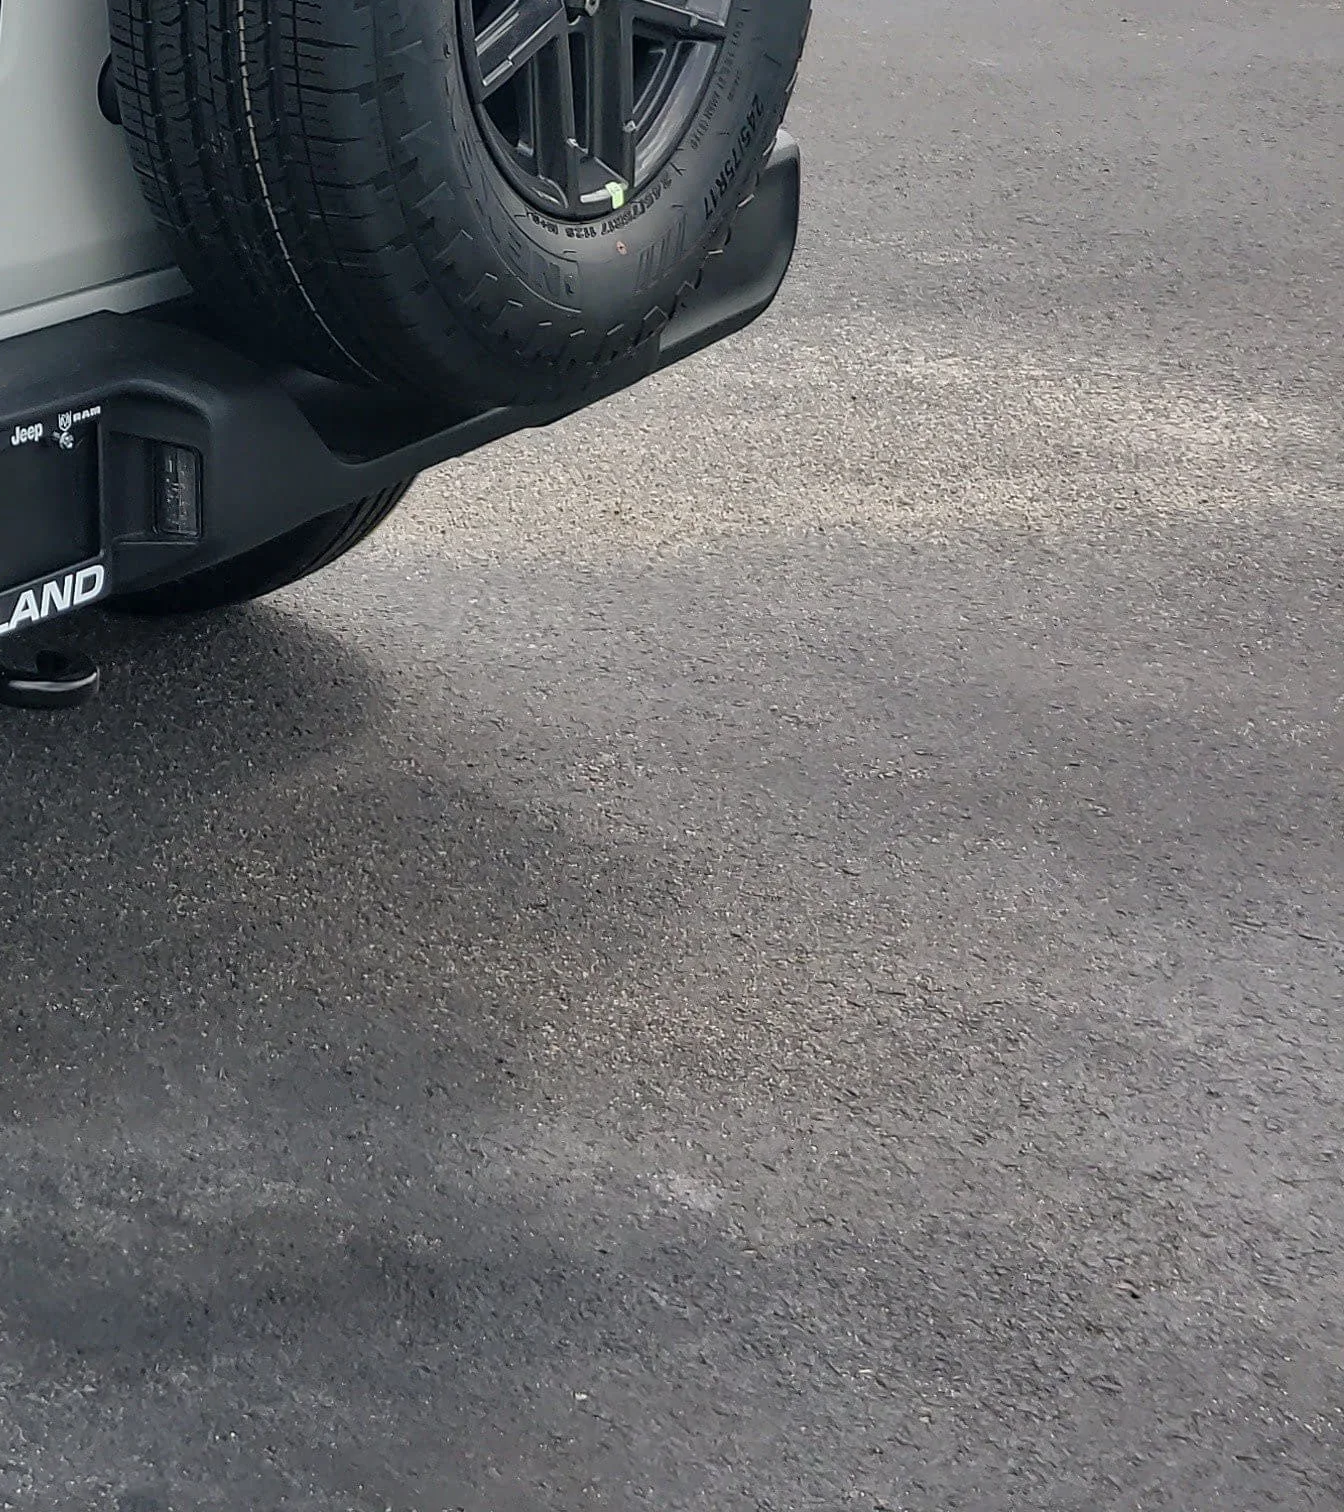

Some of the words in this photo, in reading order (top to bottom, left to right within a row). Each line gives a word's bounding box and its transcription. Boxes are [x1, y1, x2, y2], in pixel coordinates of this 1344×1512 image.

[703, 93, 765, 220] 245/75R17
[72, 405, 102, 424] RAM
[11, 422, 44, 447] Jeep
